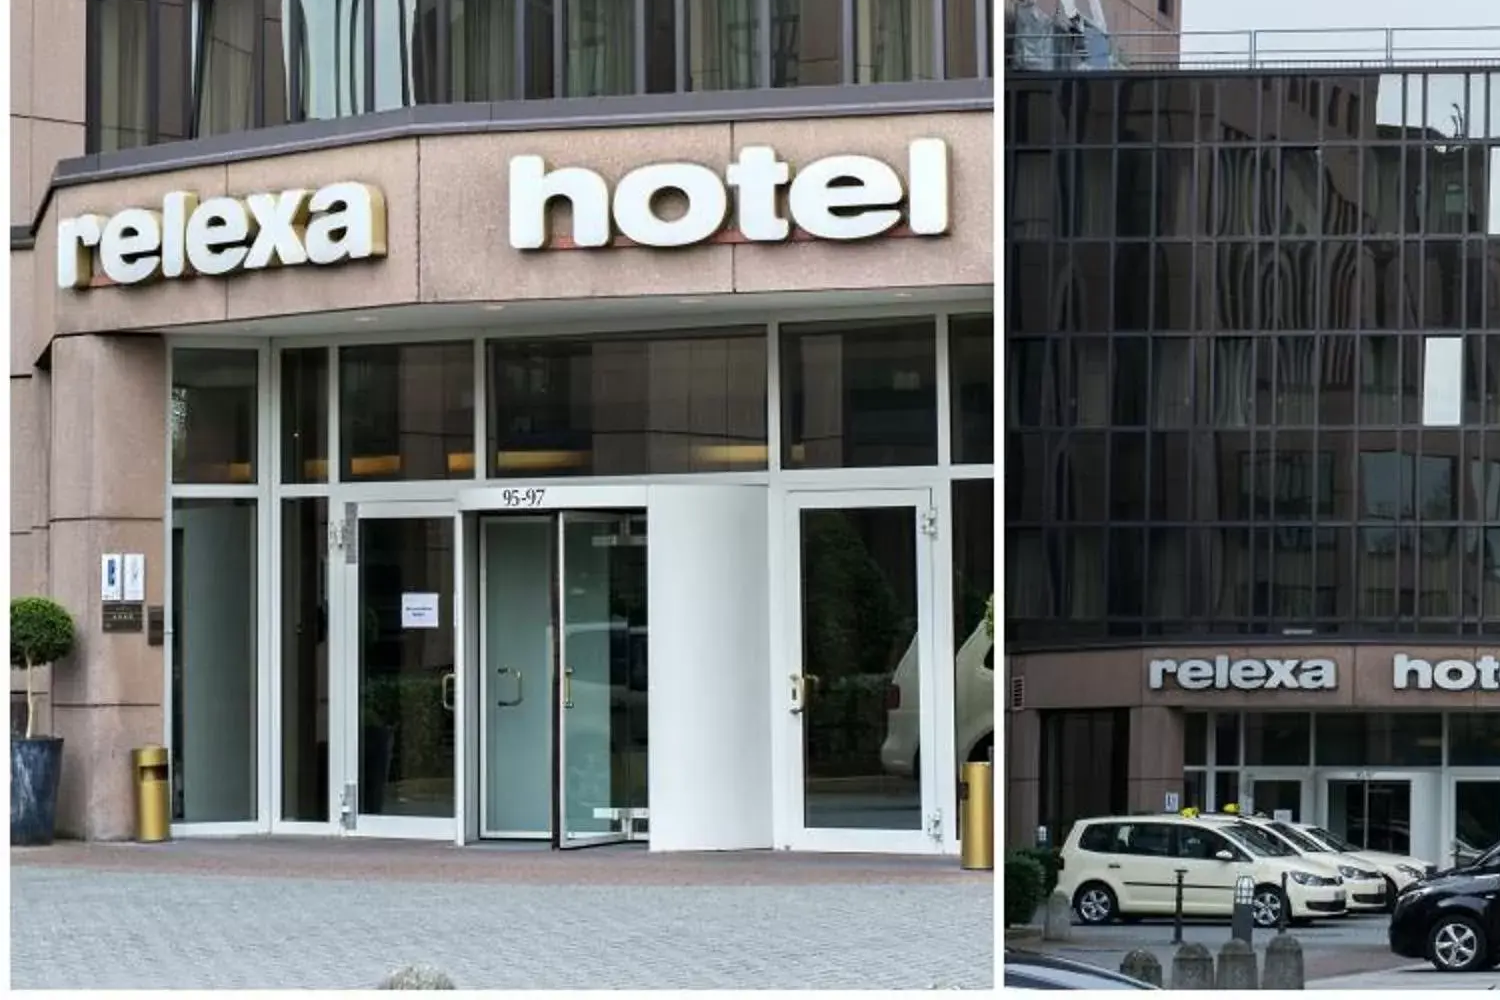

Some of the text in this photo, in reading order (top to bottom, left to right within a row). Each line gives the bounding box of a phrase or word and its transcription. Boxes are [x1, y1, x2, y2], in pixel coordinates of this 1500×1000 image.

[57, 137, 951, 290] relexa hotel
[503, 488, 545, 506] 95-97
[1148, 654, 1338, 690] relexa
